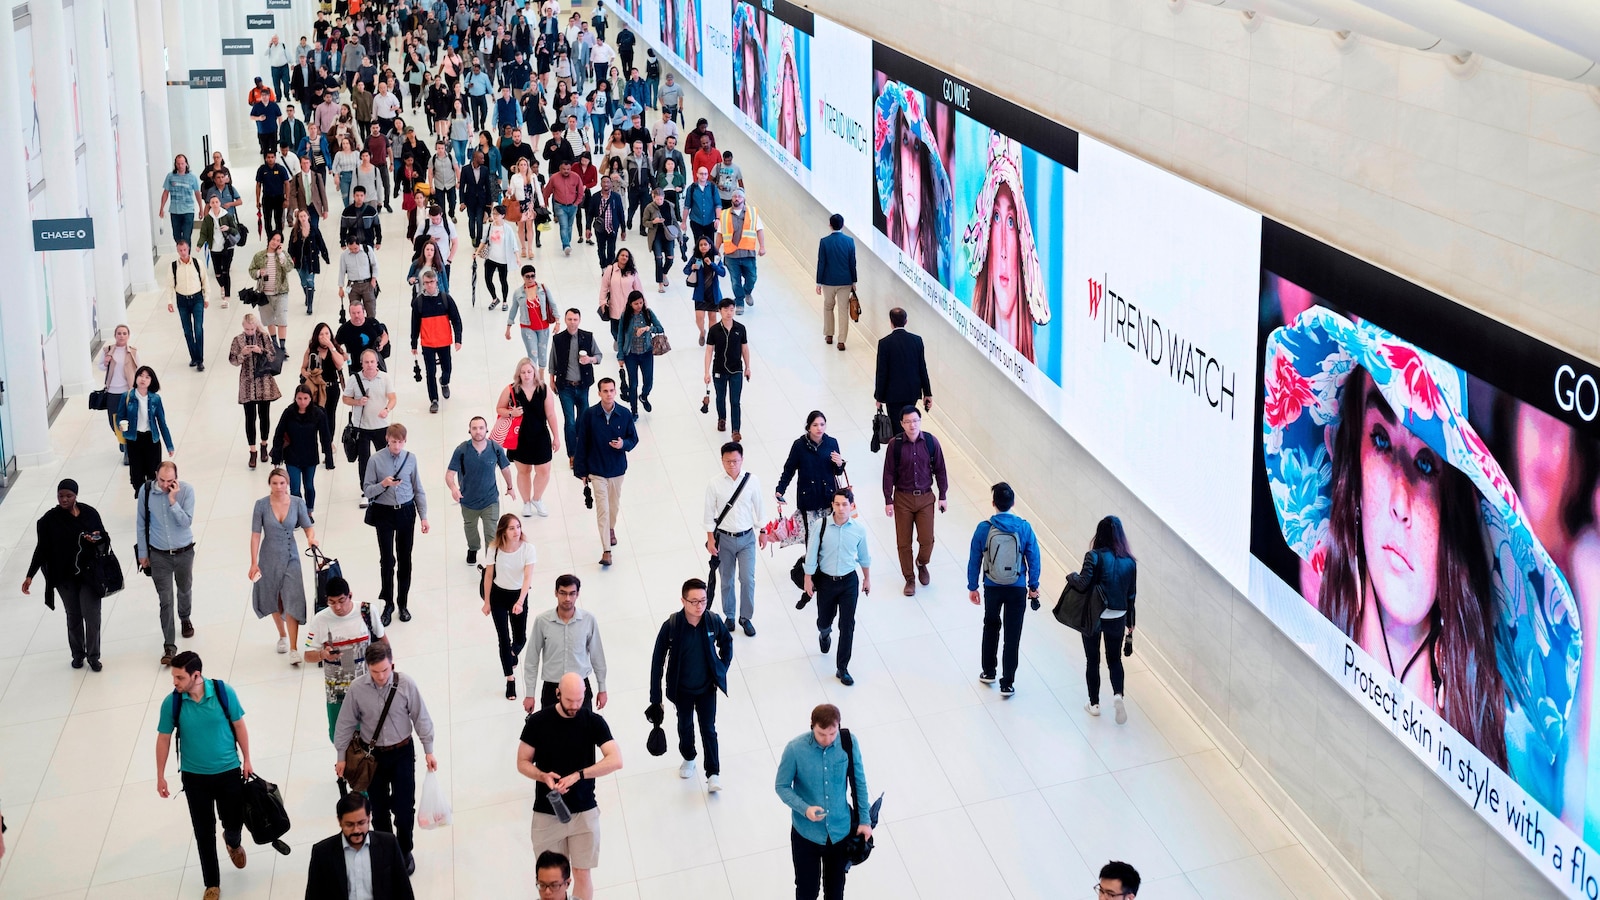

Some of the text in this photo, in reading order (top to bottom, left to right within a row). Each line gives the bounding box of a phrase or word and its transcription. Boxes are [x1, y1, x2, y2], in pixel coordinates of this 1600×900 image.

[943, 78, 970, 111] GO WIDE
[41, 231, 75, 240] CHASE
[927, 283, 938, 307] style
[938, 290, 948, 313] with
[970, 318, 989, 350] tropical
[989, 336, 1002, 362] print
[1003, 352, 1013, 373] sun
[1108, 289, 1163, 366] TREND
[1167, 328, 1235, 421] WATCH
[1554, 364, 1599, 422] GO
[1344, 642, 1398, 721] Protect
[1402, 700, 1432, 753] skin
[1438, 726, 1452, 771] in
[1458, 759, 1499, 813] style
[1506, 799, 1545, 857] with
[1552, 844, 1562, 872] a
